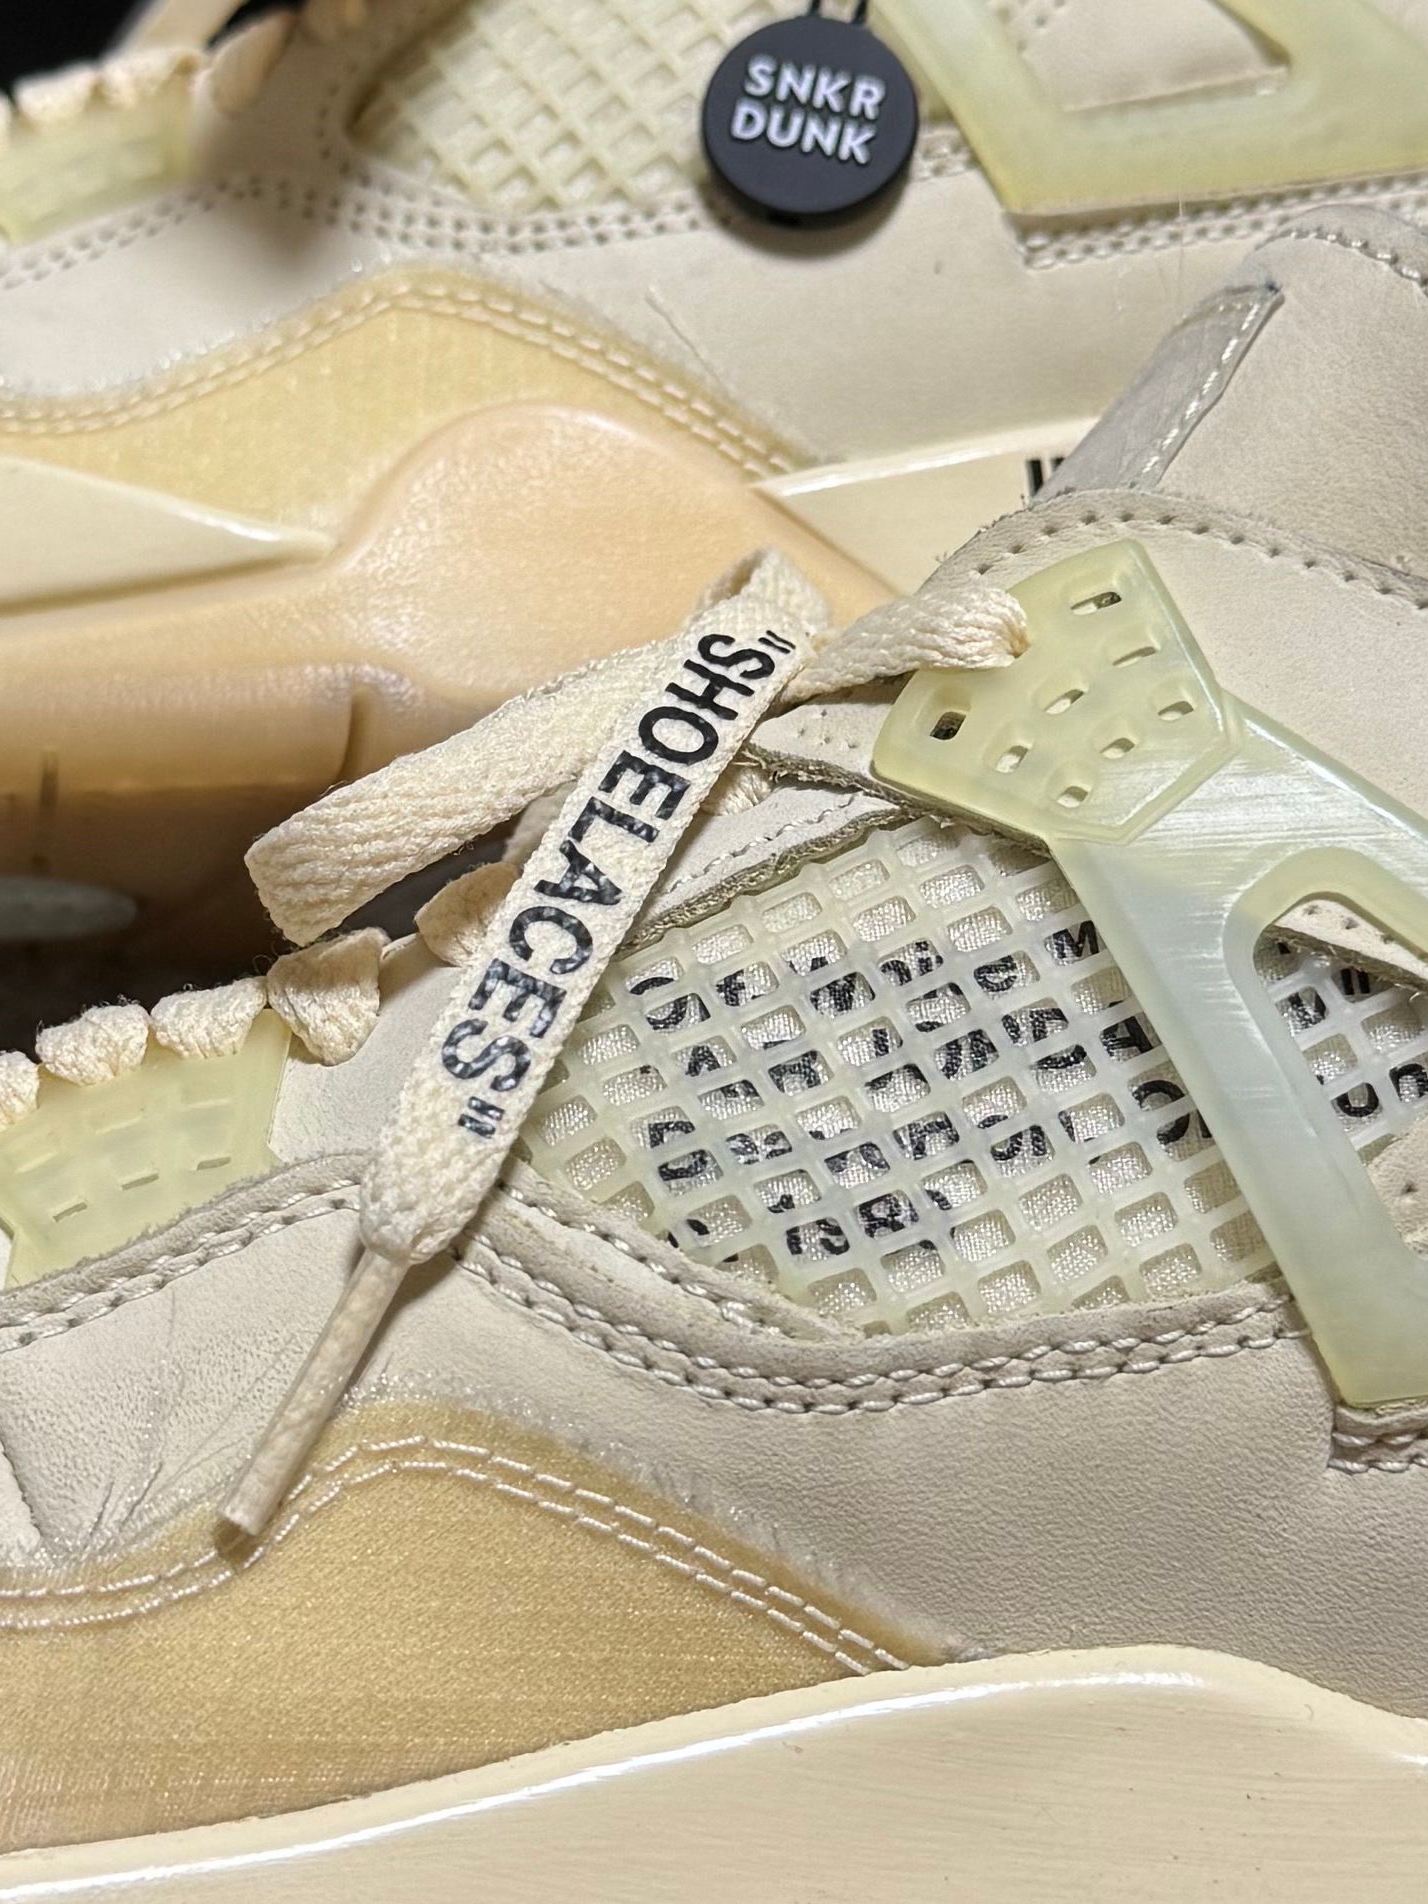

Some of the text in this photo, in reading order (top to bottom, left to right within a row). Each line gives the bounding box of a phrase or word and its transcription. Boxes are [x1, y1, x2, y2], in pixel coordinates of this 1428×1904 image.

[744, 54, 886, 120] SNKR
[730, 98, 876, 165] DUNK
[440, 628, 797, 1140] "SHOELACES"
